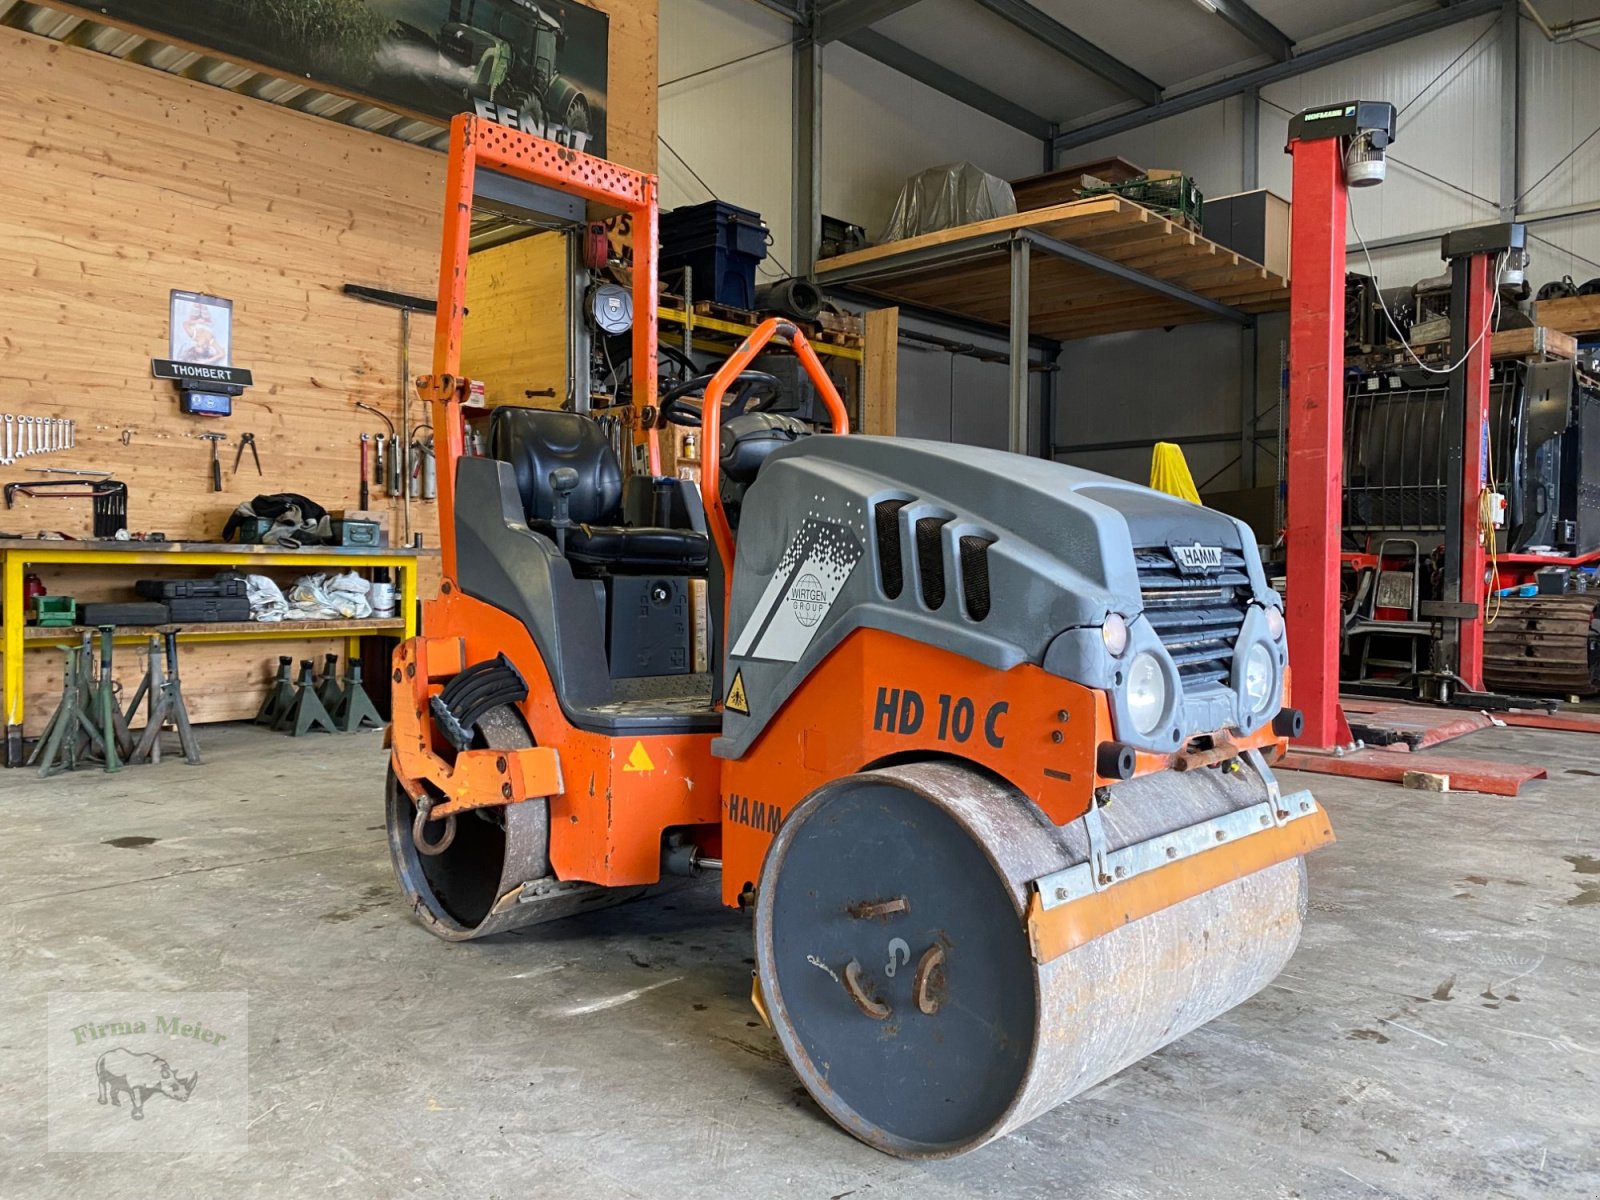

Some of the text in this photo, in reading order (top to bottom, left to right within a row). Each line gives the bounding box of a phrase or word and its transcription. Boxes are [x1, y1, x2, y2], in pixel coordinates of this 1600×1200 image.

[171, 364, 232, 381] THOMBERT
[1183, 548, 1219, 565] HAMM
[791, 588, 827, 602] WIRTGEN
[792, 601, 824, 612] GROUP
[873, 686, 1009, 749] HD 10 C
[729, 793, 782, 834] HAMM
